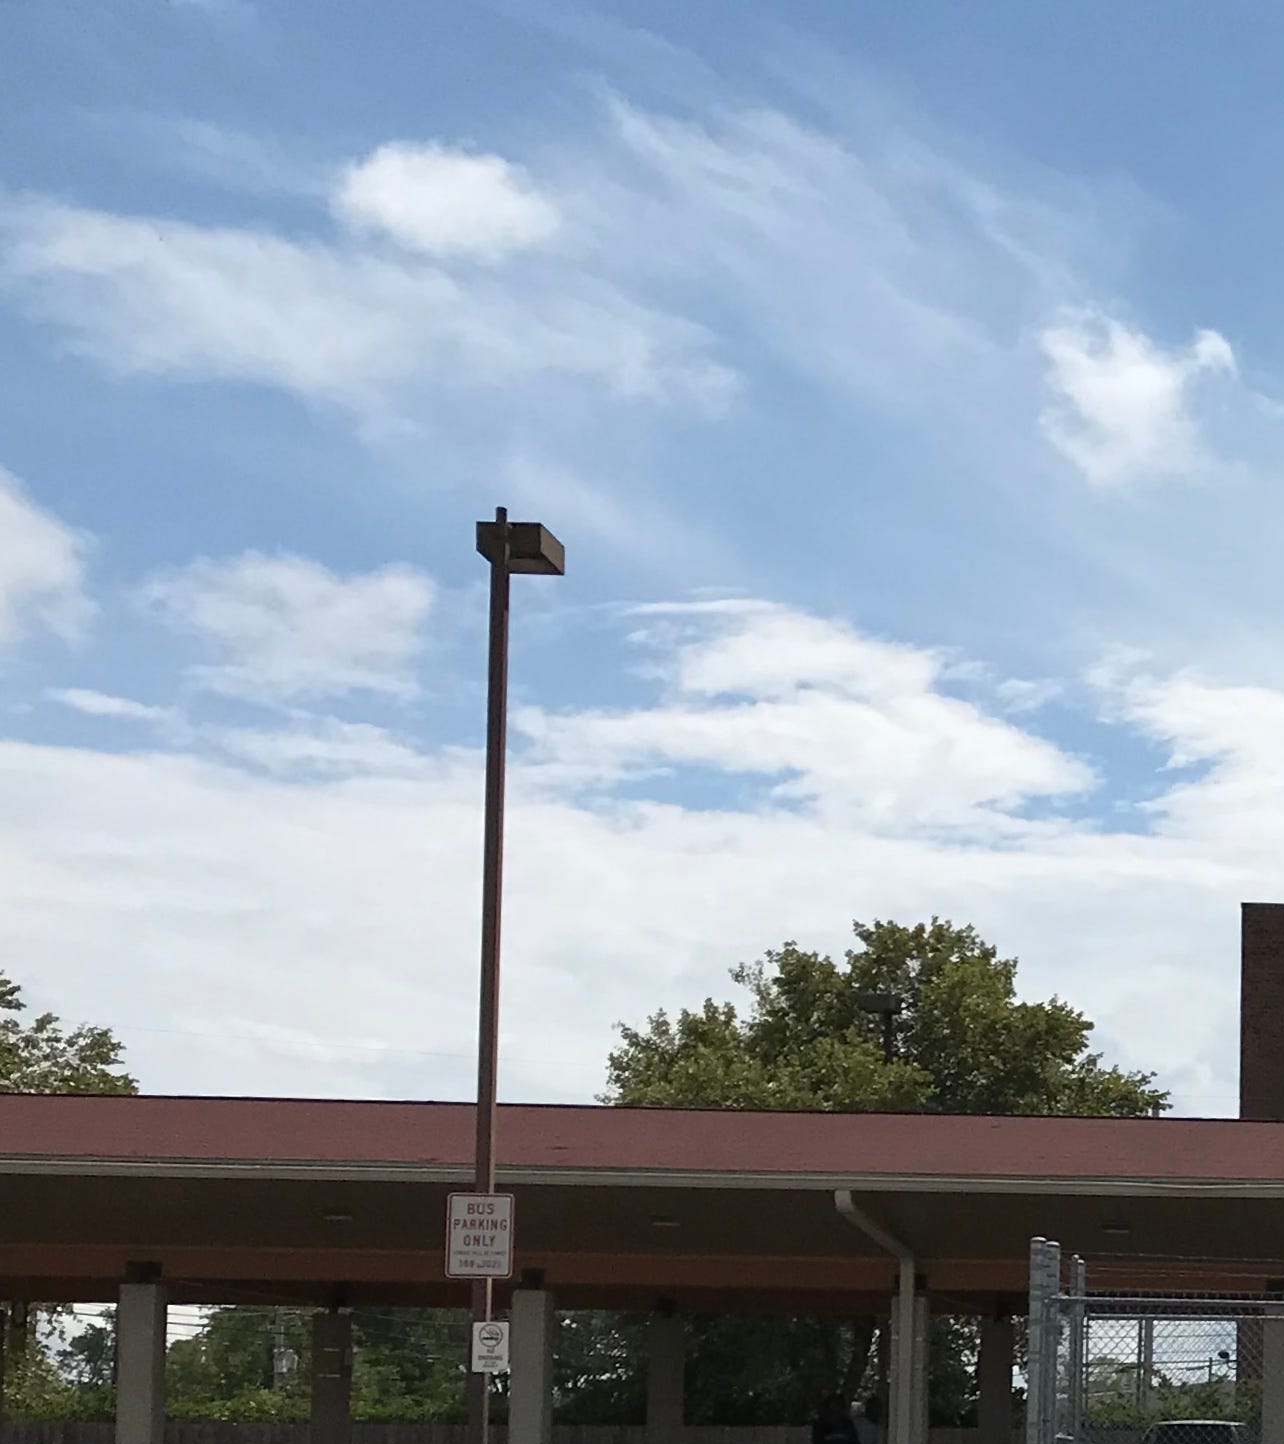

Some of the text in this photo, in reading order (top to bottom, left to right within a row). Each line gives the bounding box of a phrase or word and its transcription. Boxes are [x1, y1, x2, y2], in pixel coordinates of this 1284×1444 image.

[467, 1202, 495, 1215] BUS
[453, 1218, 508, 1232] PARKING
[463, 1234, 496, 1248] ONLY
